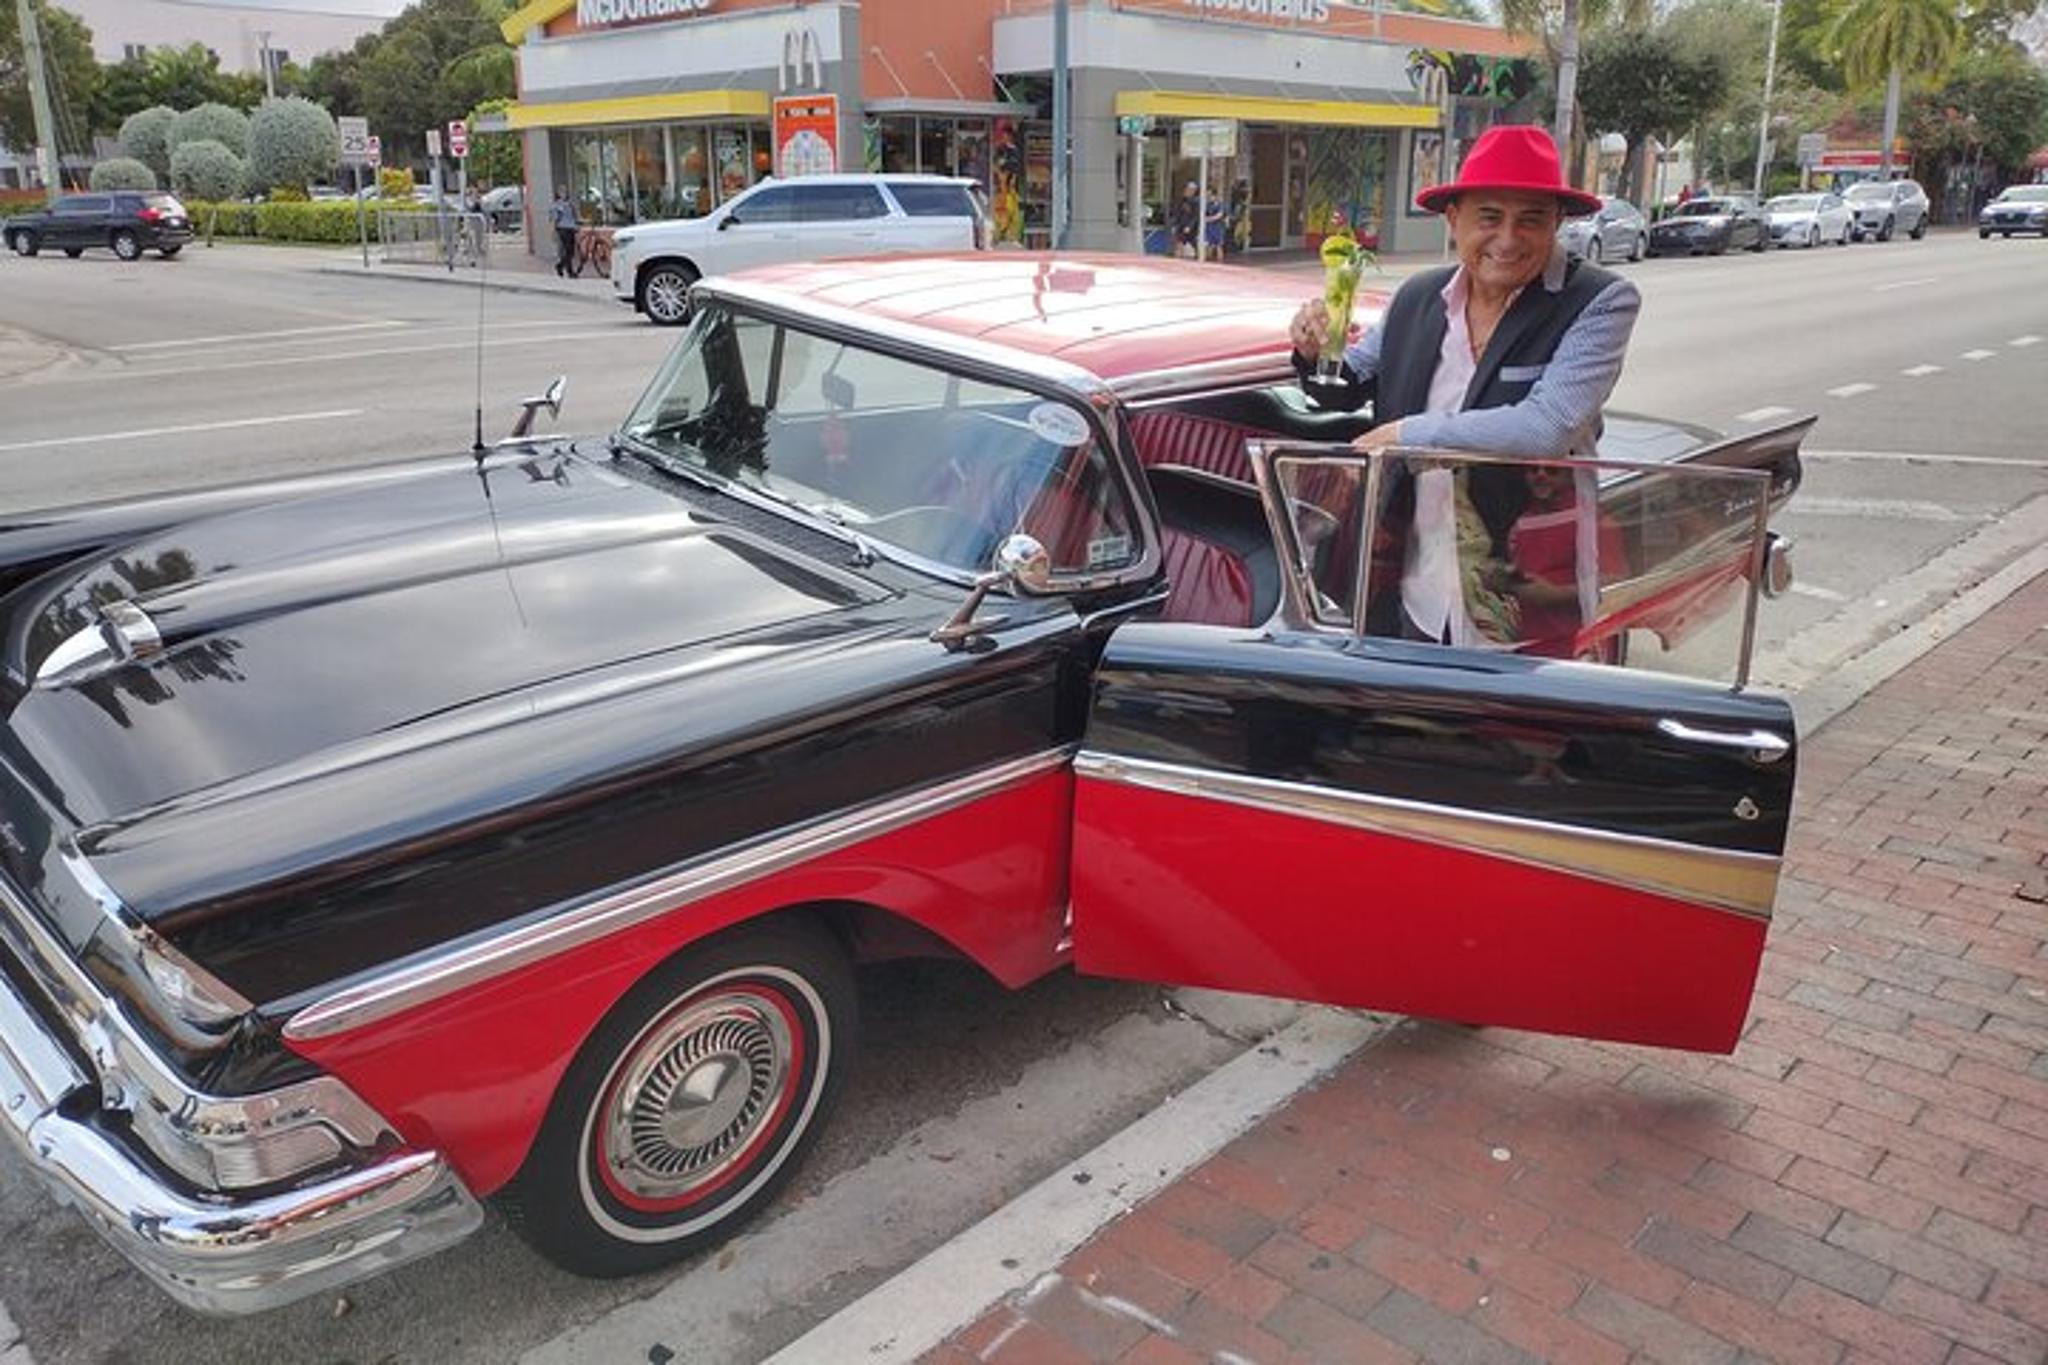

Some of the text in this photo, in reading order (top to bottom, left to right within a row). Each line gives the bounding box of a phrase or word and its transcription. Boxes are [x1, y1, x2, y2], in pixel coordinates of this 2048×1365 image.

[577, 0, 710, 26] McDona
[1187, 0, 1329, 23] onalds
[344, 136, 366, 151] 25
